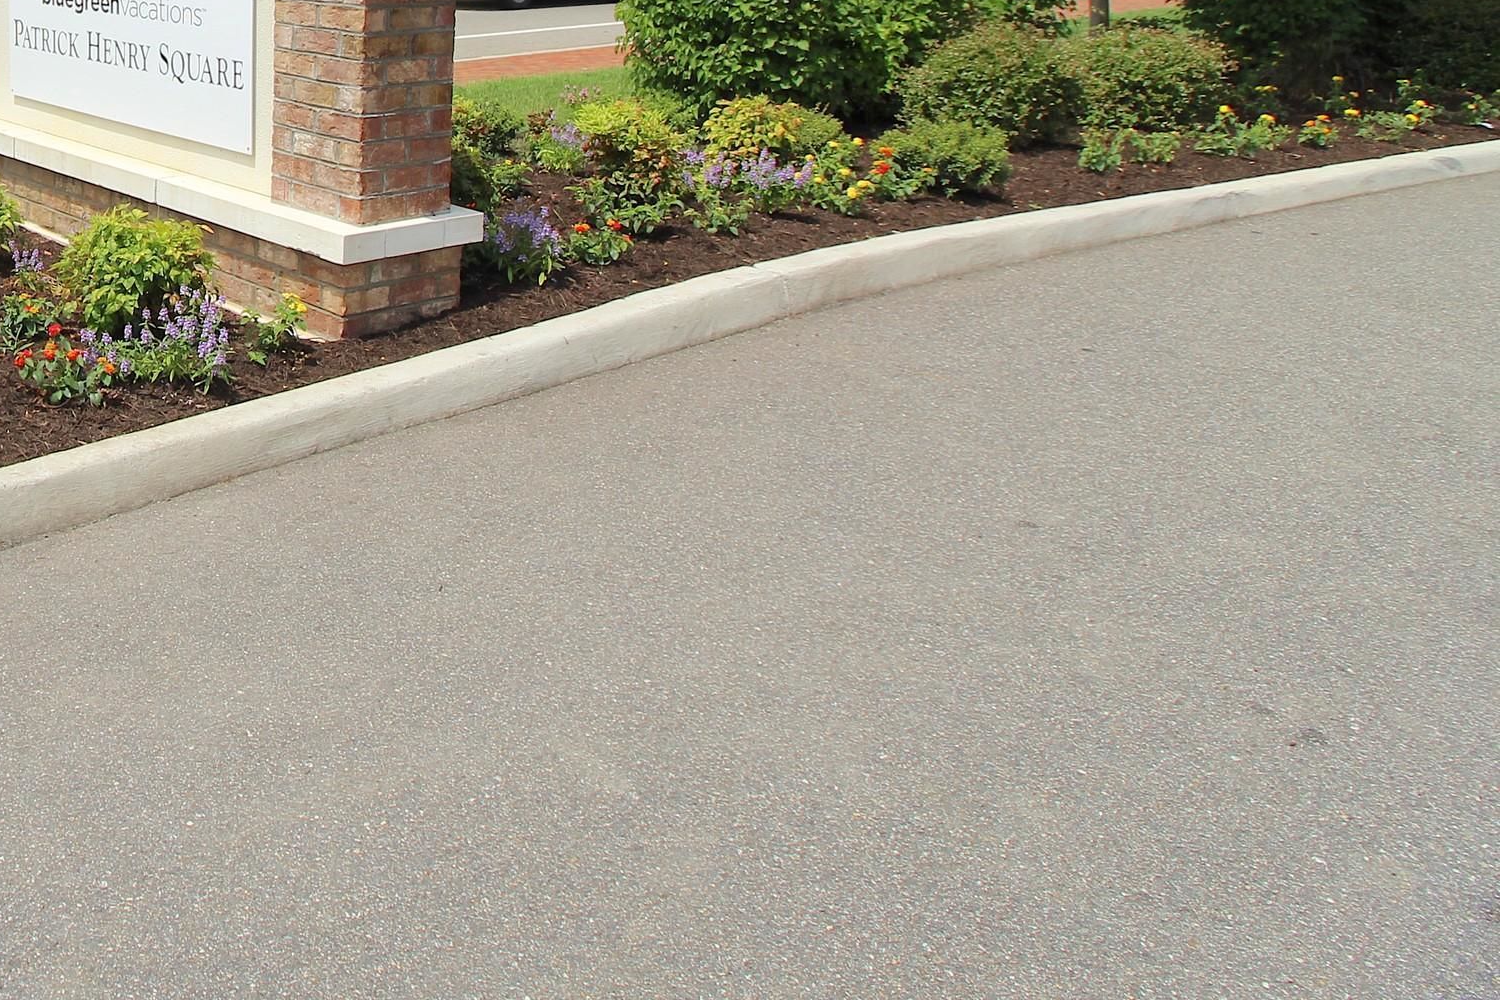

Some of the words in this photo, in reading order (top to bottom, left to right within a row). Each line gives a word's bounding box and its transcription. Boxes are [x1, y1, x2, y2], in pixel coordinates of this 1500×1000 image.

[13, 18, 79, 58] PATRICK
[87, 31, 150, 71] HENRY
[159, 42, 244, 90] SQUARE
